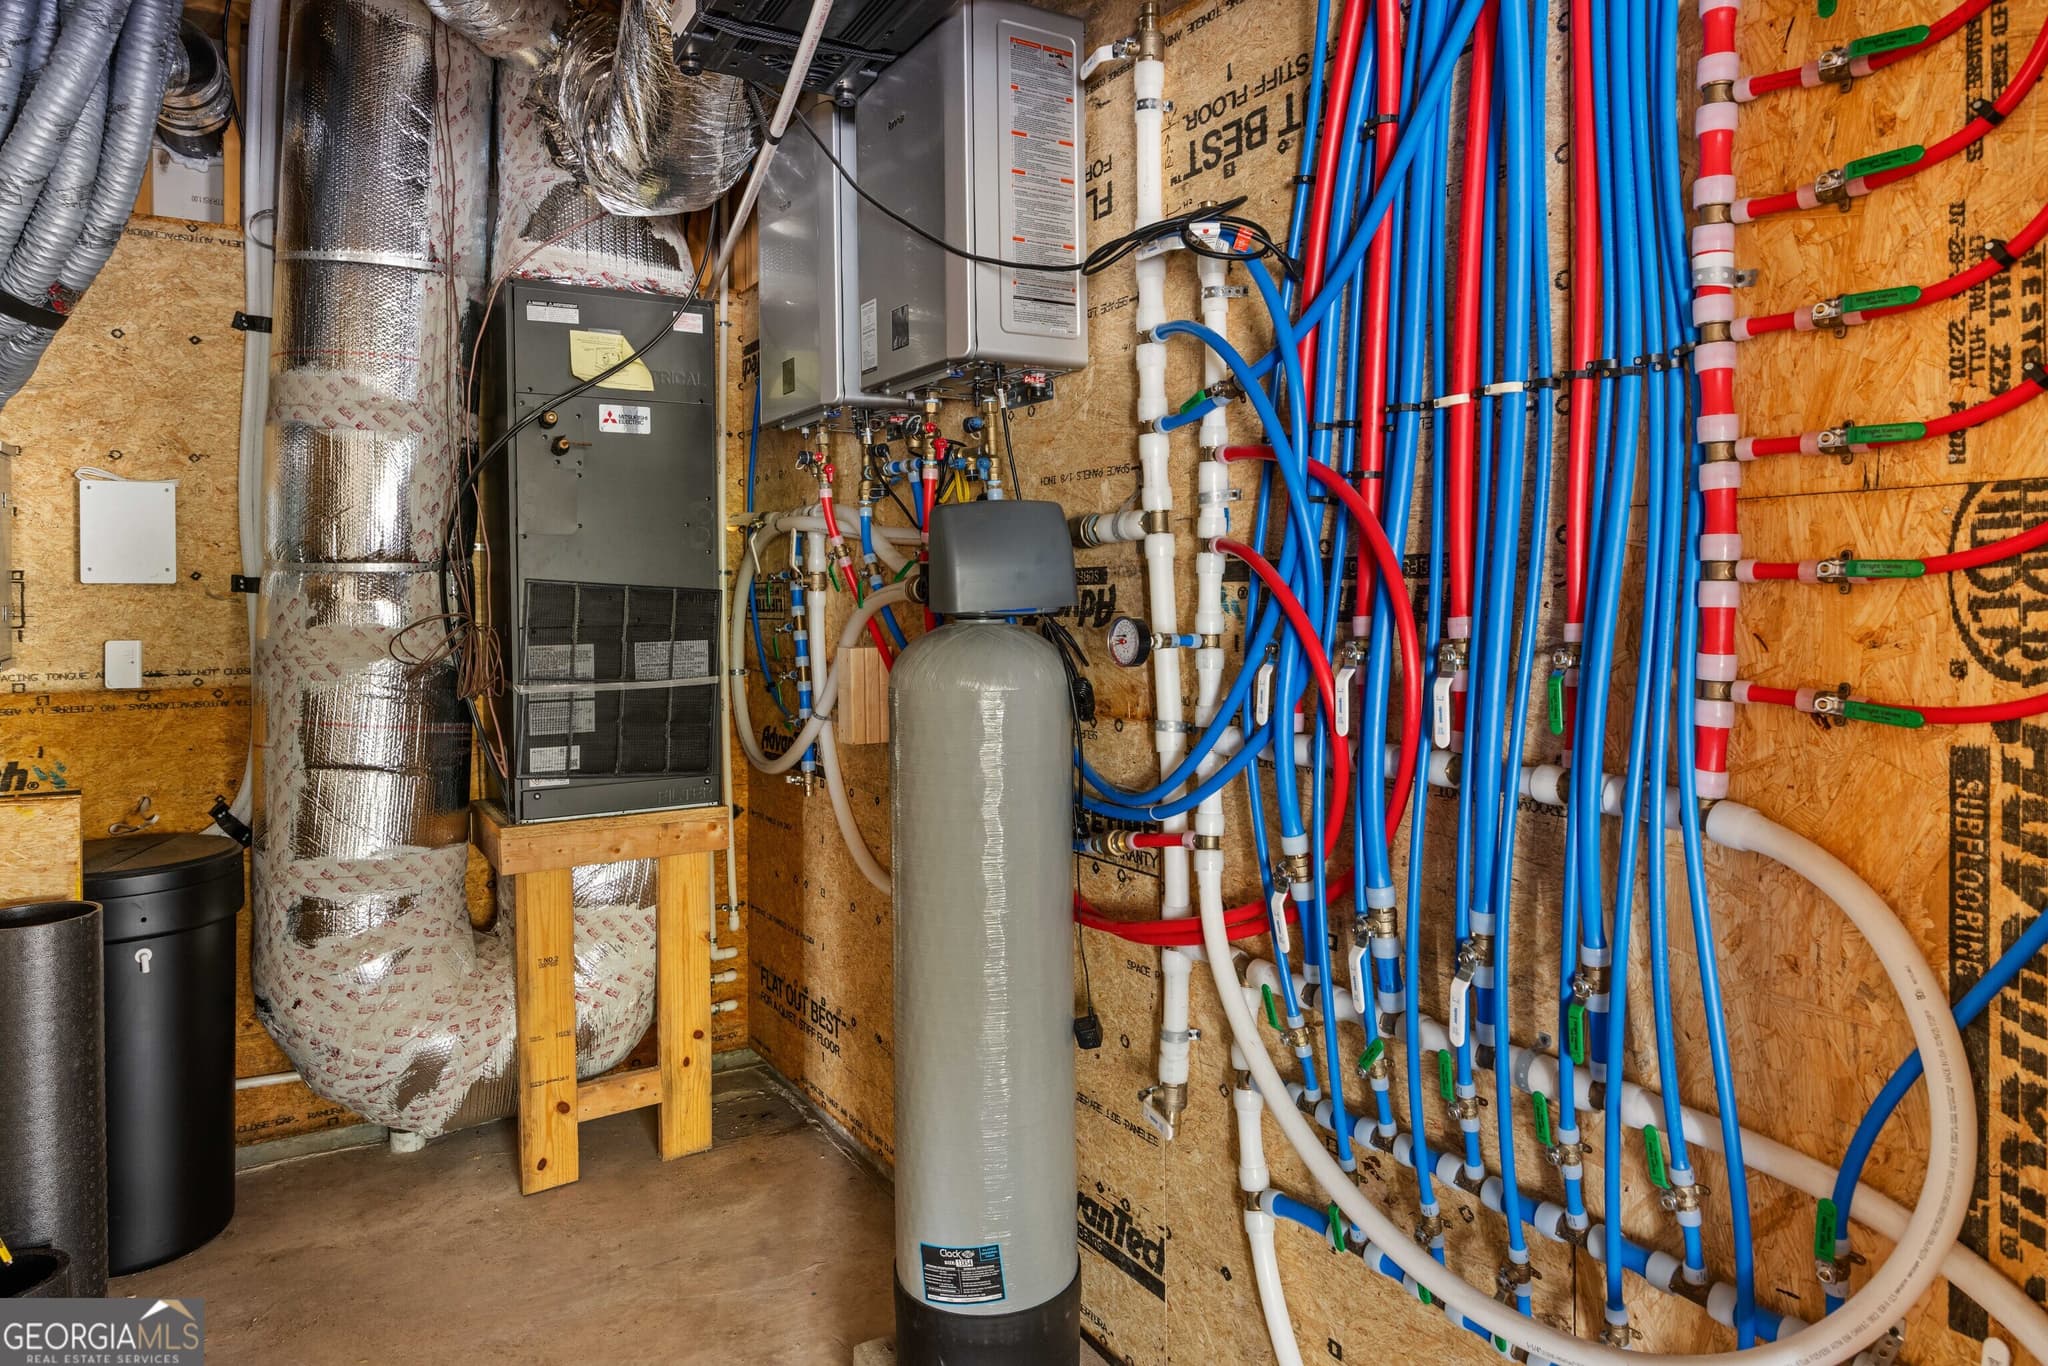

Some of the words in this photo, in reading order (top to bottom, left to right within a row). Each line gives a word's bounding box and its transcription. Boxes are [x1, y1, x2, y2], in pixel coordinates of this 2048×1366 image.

[1184, 5, 1222, 36] TONGUE
[1252, 52, 1309, 98] STIFF
[617, 413, 649, 421] MITSUBISHI
[617, 418, 645, 426] ELECTRIC
[1075, 467, 1105, 482] PANELS
[1106, 462, 1132, 477] SPACE
[46, 671, 90, 682] TONGUE
[28, 707, 45, 716] LA
[51, 703, 95, 715] CIERRE
[1953, 777, 1986, 979] SUBFLOORING
[1126, 959, 1151, 979] SPACE
[760, 966, 784, 999] FLAT
[785, 983, 809, 1017] OUT
[798, 1018, 816, 1038] STIFF
